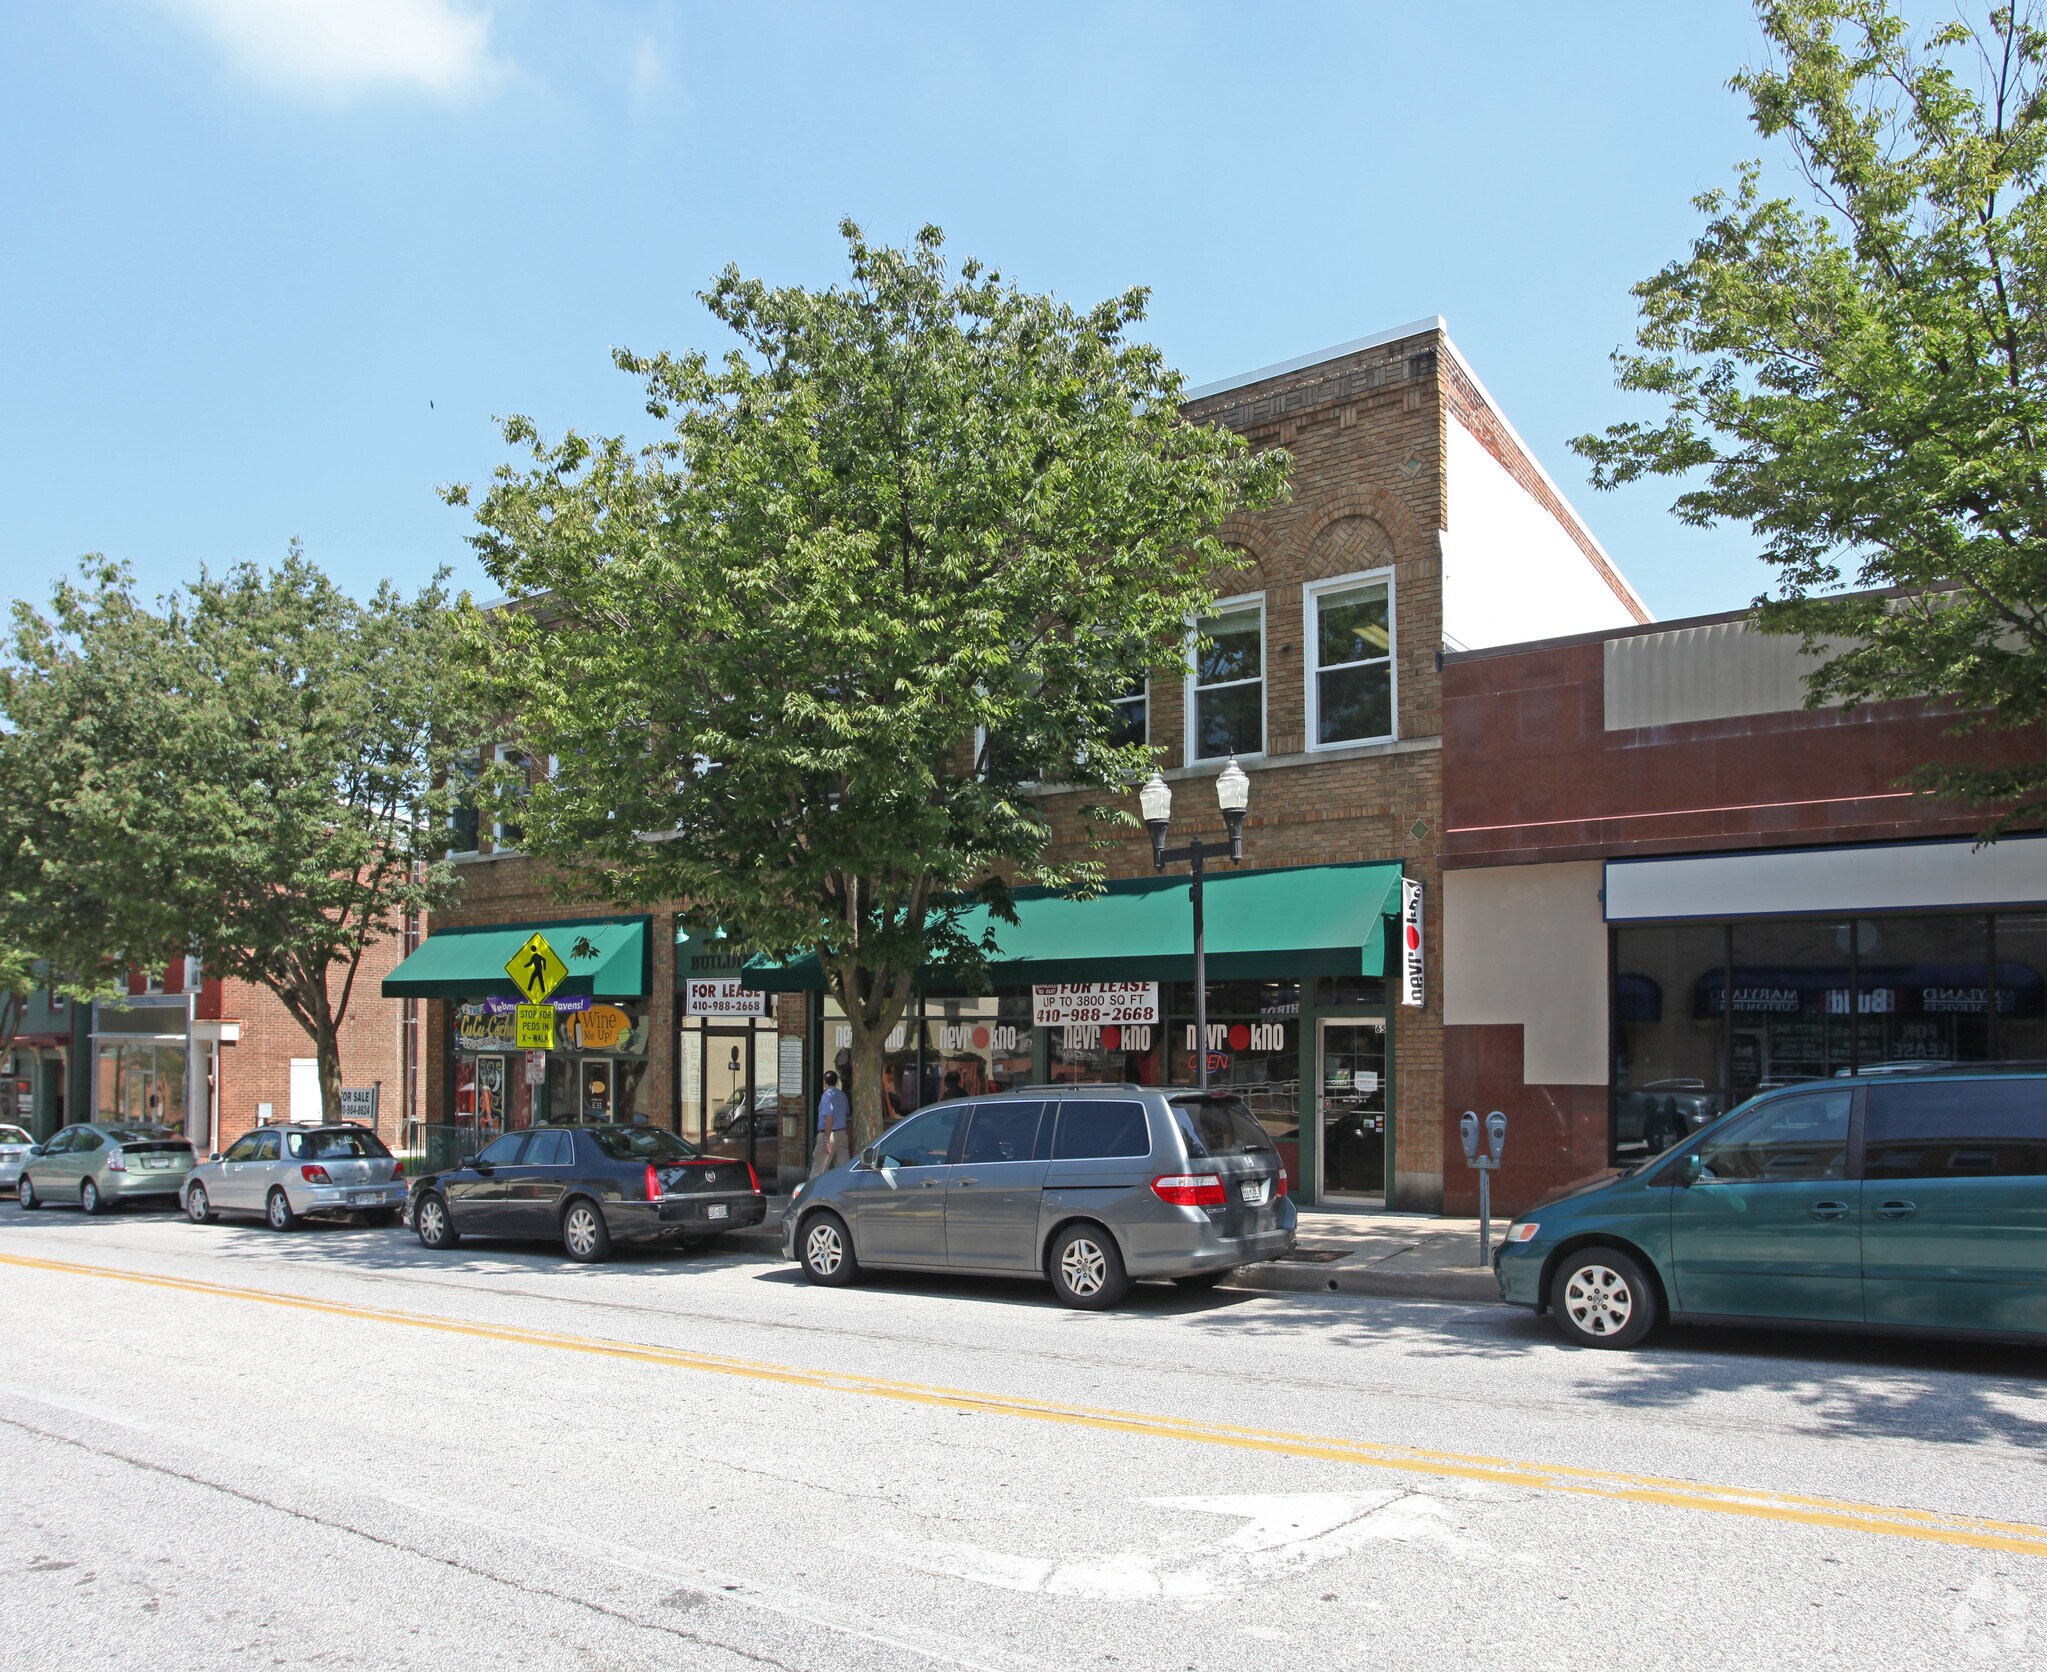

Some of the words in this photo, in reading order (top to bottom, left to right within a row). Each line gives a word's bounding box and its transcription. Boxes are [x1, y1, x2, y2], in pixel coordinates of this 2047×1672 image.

[692, 984, 716, 998] FOR
[1061, 982, 1092, 994] FOR
[1099, 981, 1151, 993] LEASE
[692, 1001, 760, 1011] 410-988-2668
[1043, 997, 1056, 1007] UP
[1060, 996, 1072, 1006] TO
[1076, 995, 1105, 1006] 3800
[1110, 994, 1125, 1005] SQ
[1130, 994, 1144, 1004] FT
[520, 1010, 537, 1019] STOP
[540, 1011, 552, 1019] FOR
[582, 1011, 617, 1029] Wine
[1036, 1006, 1154, 1022] 410-988-2668
[522, 1022, 540, 1031] PEDS
[542, 1023, 549, 1031] IN
[584, 1031, 595, 1041] Me
[597, 1030, 612, 1043] Up!
[353, 1091, 370, 1102] SALE
